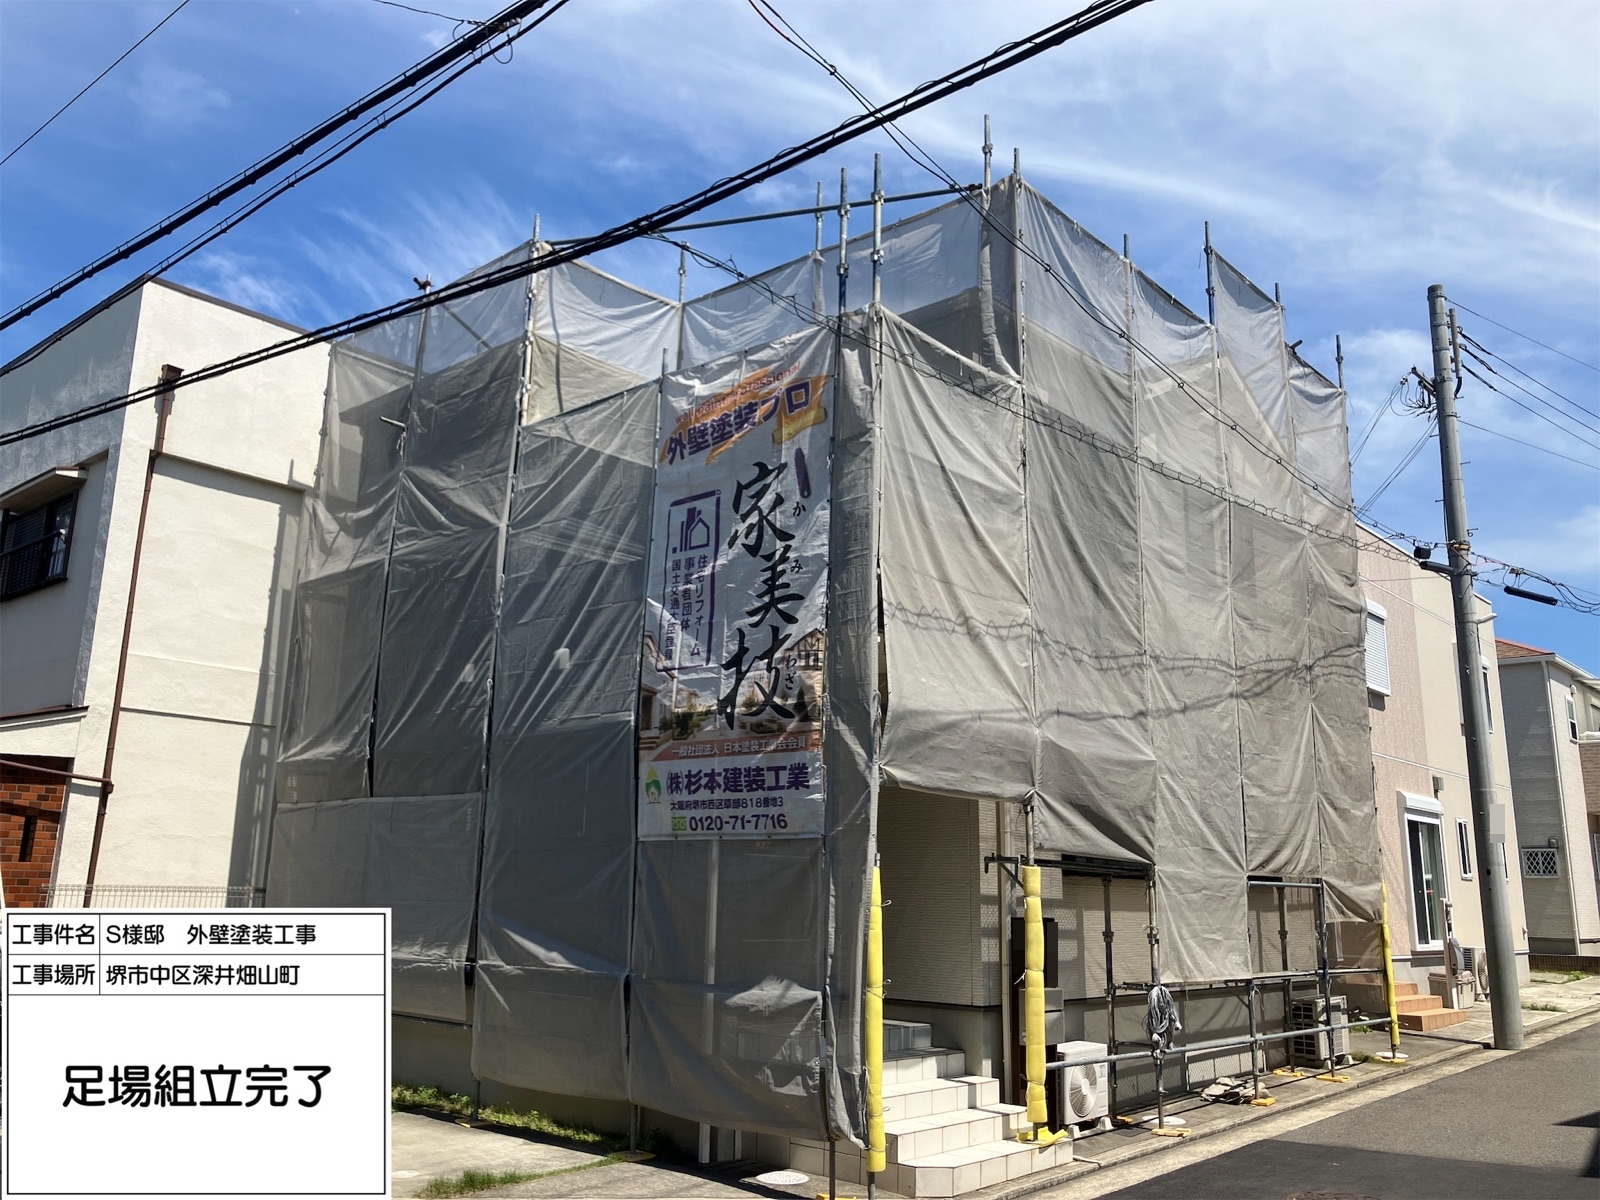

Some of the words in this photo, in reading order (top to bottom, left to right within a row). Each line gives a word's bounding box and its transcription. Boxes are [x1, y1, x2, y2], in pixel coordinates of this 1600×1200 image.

[666, 379, 812, 466] 外壁塗装プロ
[792, 501, 807, 518] か
[790, 559, 803, 574] み
[681, 556, 696, 632] 事業者団体
[717, 461, 805, 731] 家美技
[784, 655, 797, 690] わざ
[671, 743, 720, 757] 一般社団法人
[689, 813, 788, 832] 0120-71-7716
